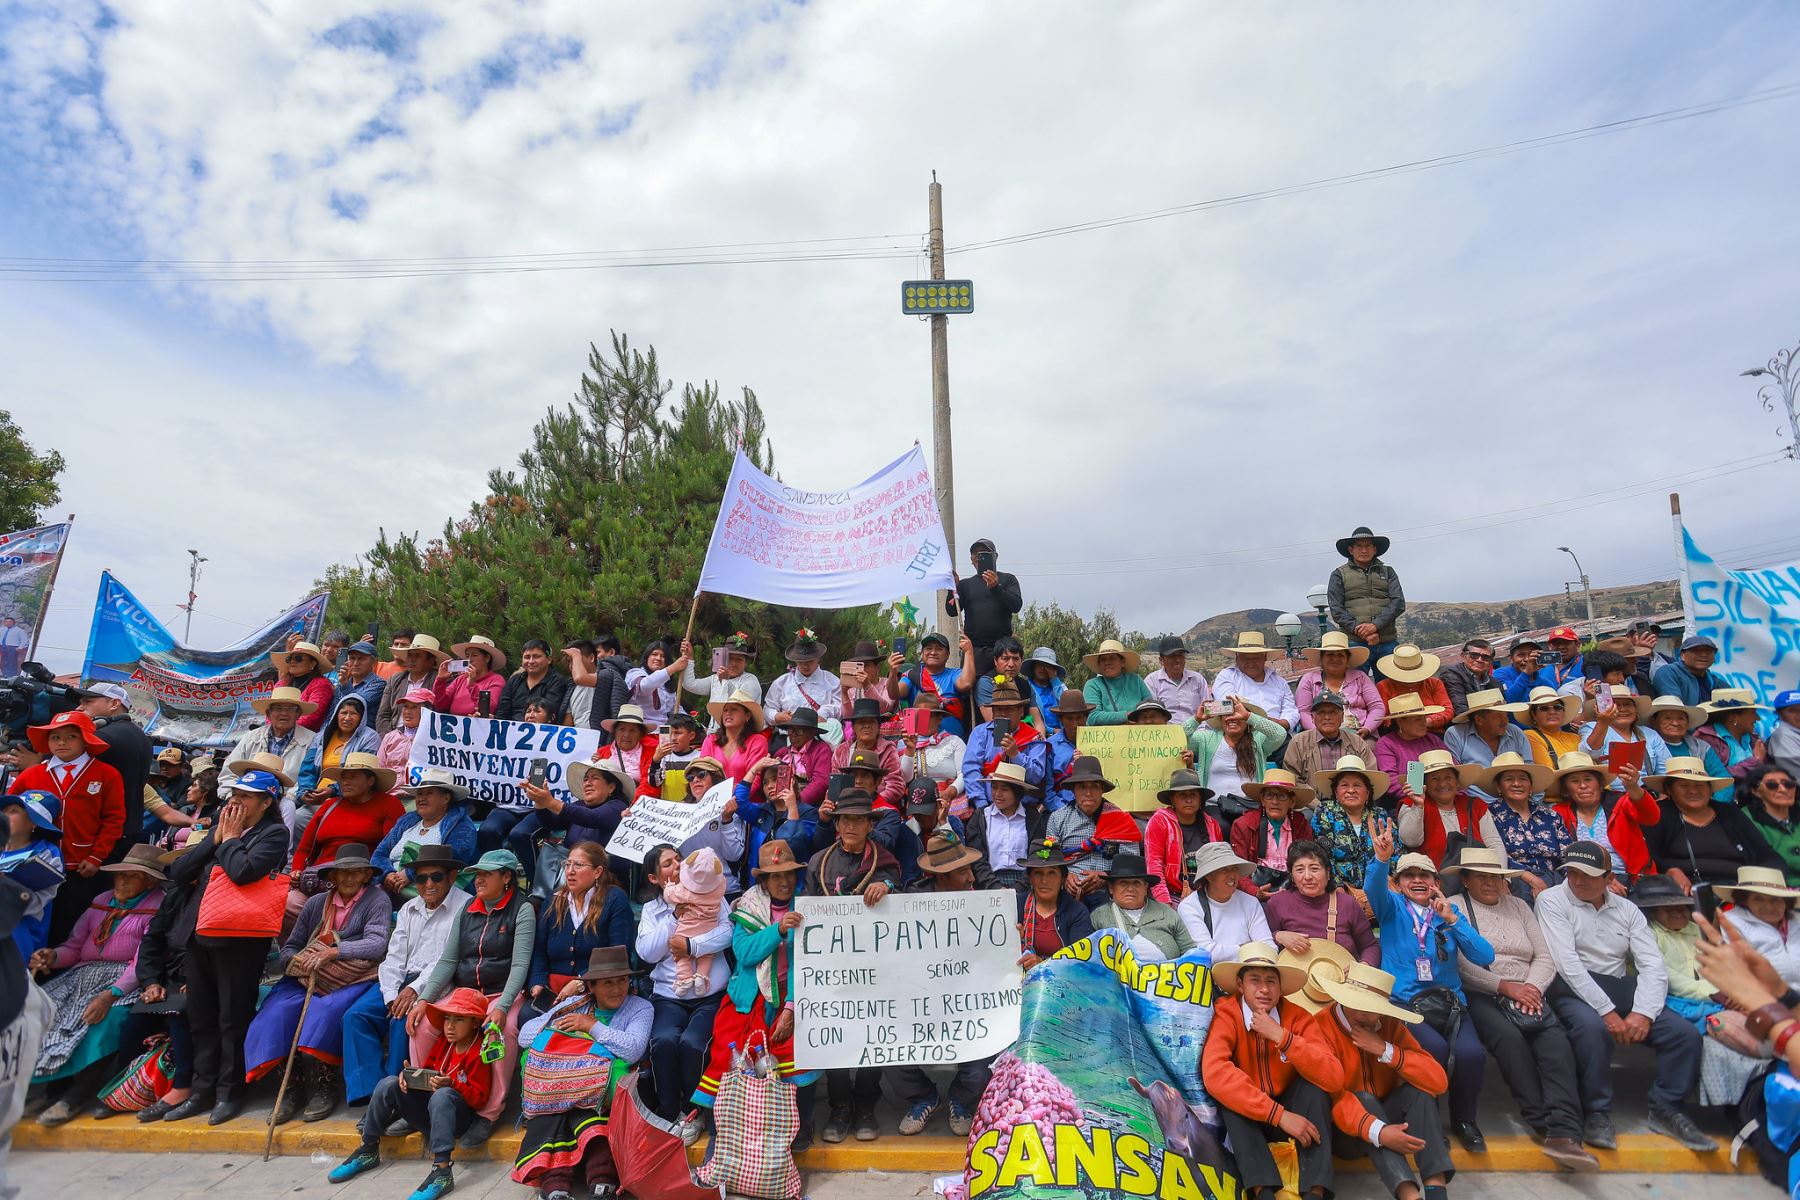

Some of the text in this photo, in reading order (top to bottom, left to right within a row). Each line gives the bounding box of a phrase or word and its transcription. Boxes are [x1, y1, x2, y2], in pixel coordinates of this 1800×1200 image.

[782, 487, 851, 506] SANSAYCCA
[514, 722, 578, 754] 276
[1082, 729, 1171, 743] ANEXO AYCARA
[1089, 747, 1113, 759] PIDE
[428, 745, 562, 784] BIENVENIO
[1128, 763, 1143, 776] DE
[1128, 779, 1134, 791] Y
[623, 818, 637, 829] de
[613, 831, 645, 853] de la
[803, 896, 1002, 919] COMUNIDAD CAMPESINA DE
[803, 914, 1007, 954] CALPAMAYO
[801, 958, 970, 988] PRESENTE SEÑOR
[797, 989, 1023, 1021] PRESIDENTE TE RECIBIMOS
[808, 1018, 989, 1048] CON LOS BRAZOS
[859, 1044, 957, 1065] ABIERTOS
